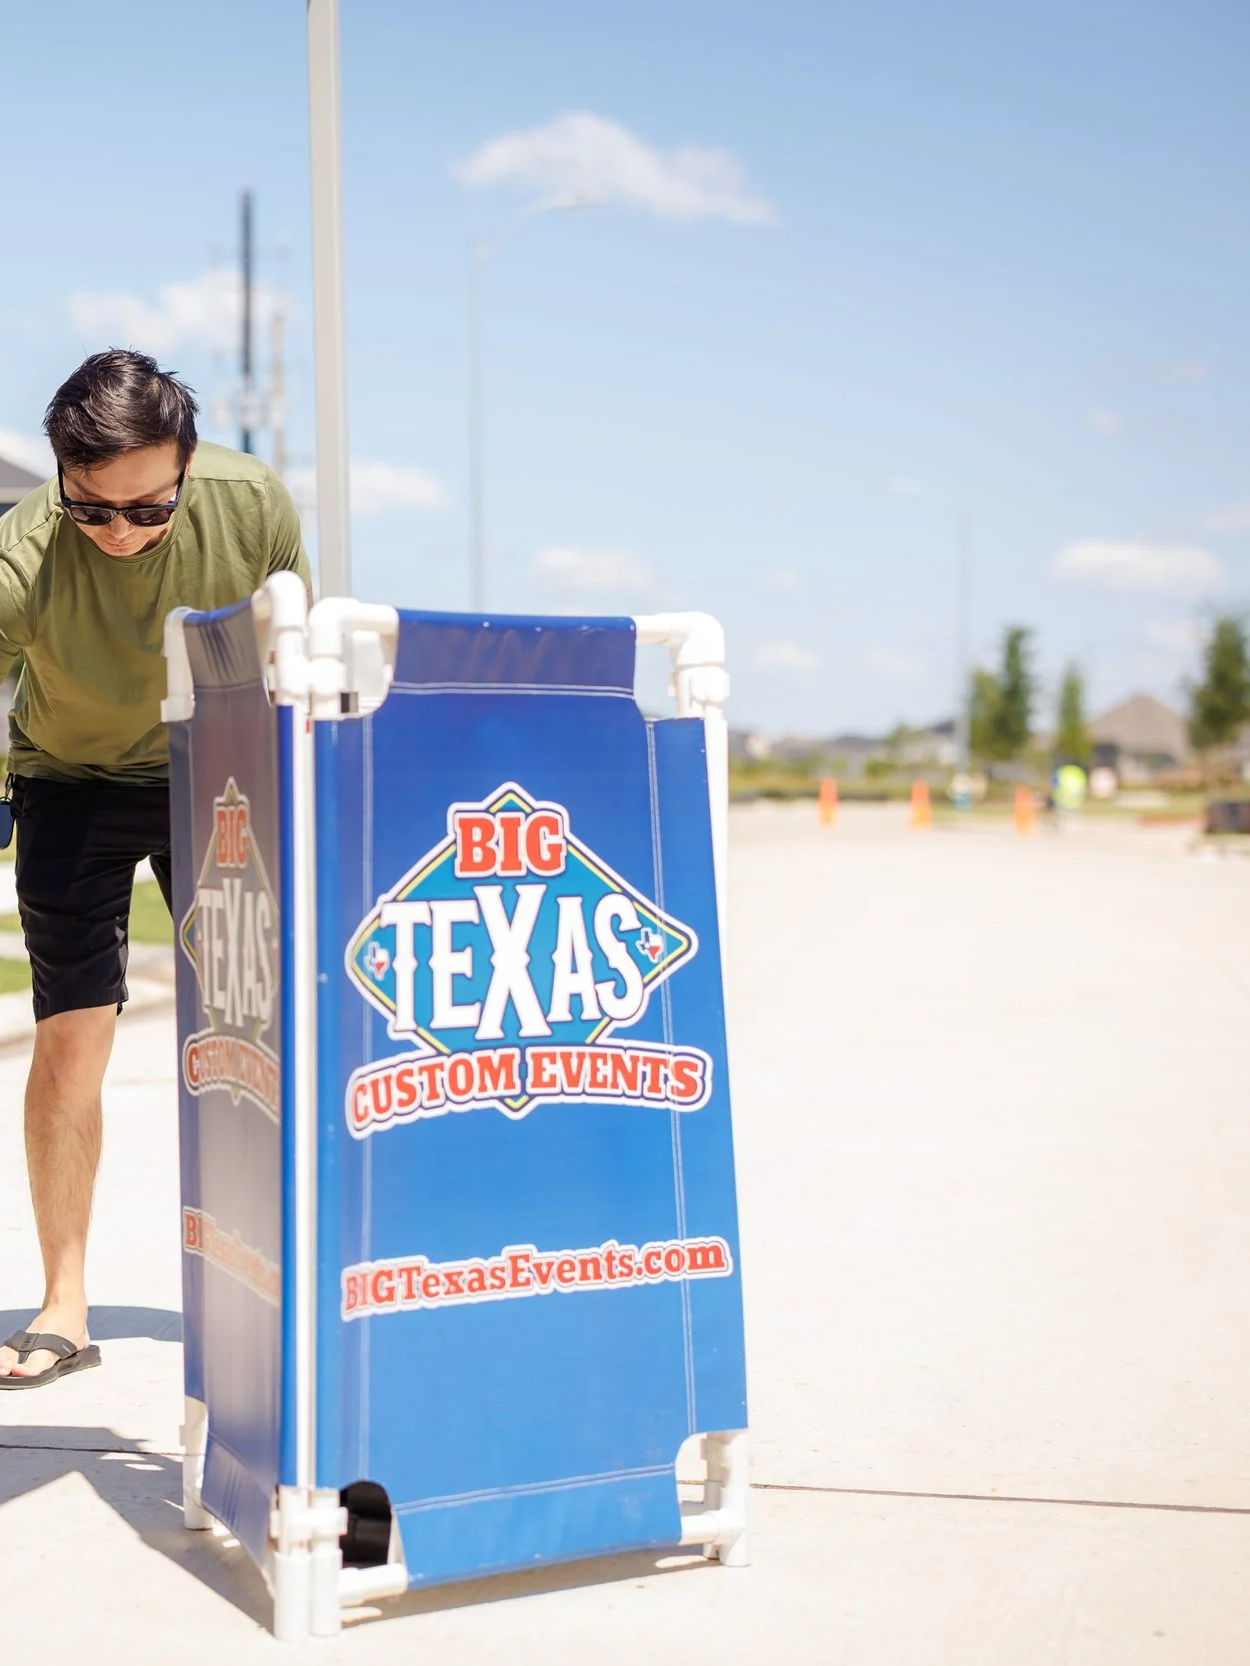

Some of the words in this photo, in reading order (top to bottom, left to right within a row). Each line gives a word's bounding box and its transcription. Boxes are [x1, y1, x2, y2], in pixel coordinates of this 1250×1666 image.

[216, 808, 249, 864] BIG
[457, 815, 564, 874] BIG
[198, 877, 273, 1028] TEXAS
[380, 883, 644, 1040] TEXAS
[353, 1053, 516, 1123] CUSTOM
[530, 1051, 700, 1099] EVENTS
[344, 1242, 725, 1311] BIGTexasEvents.com
